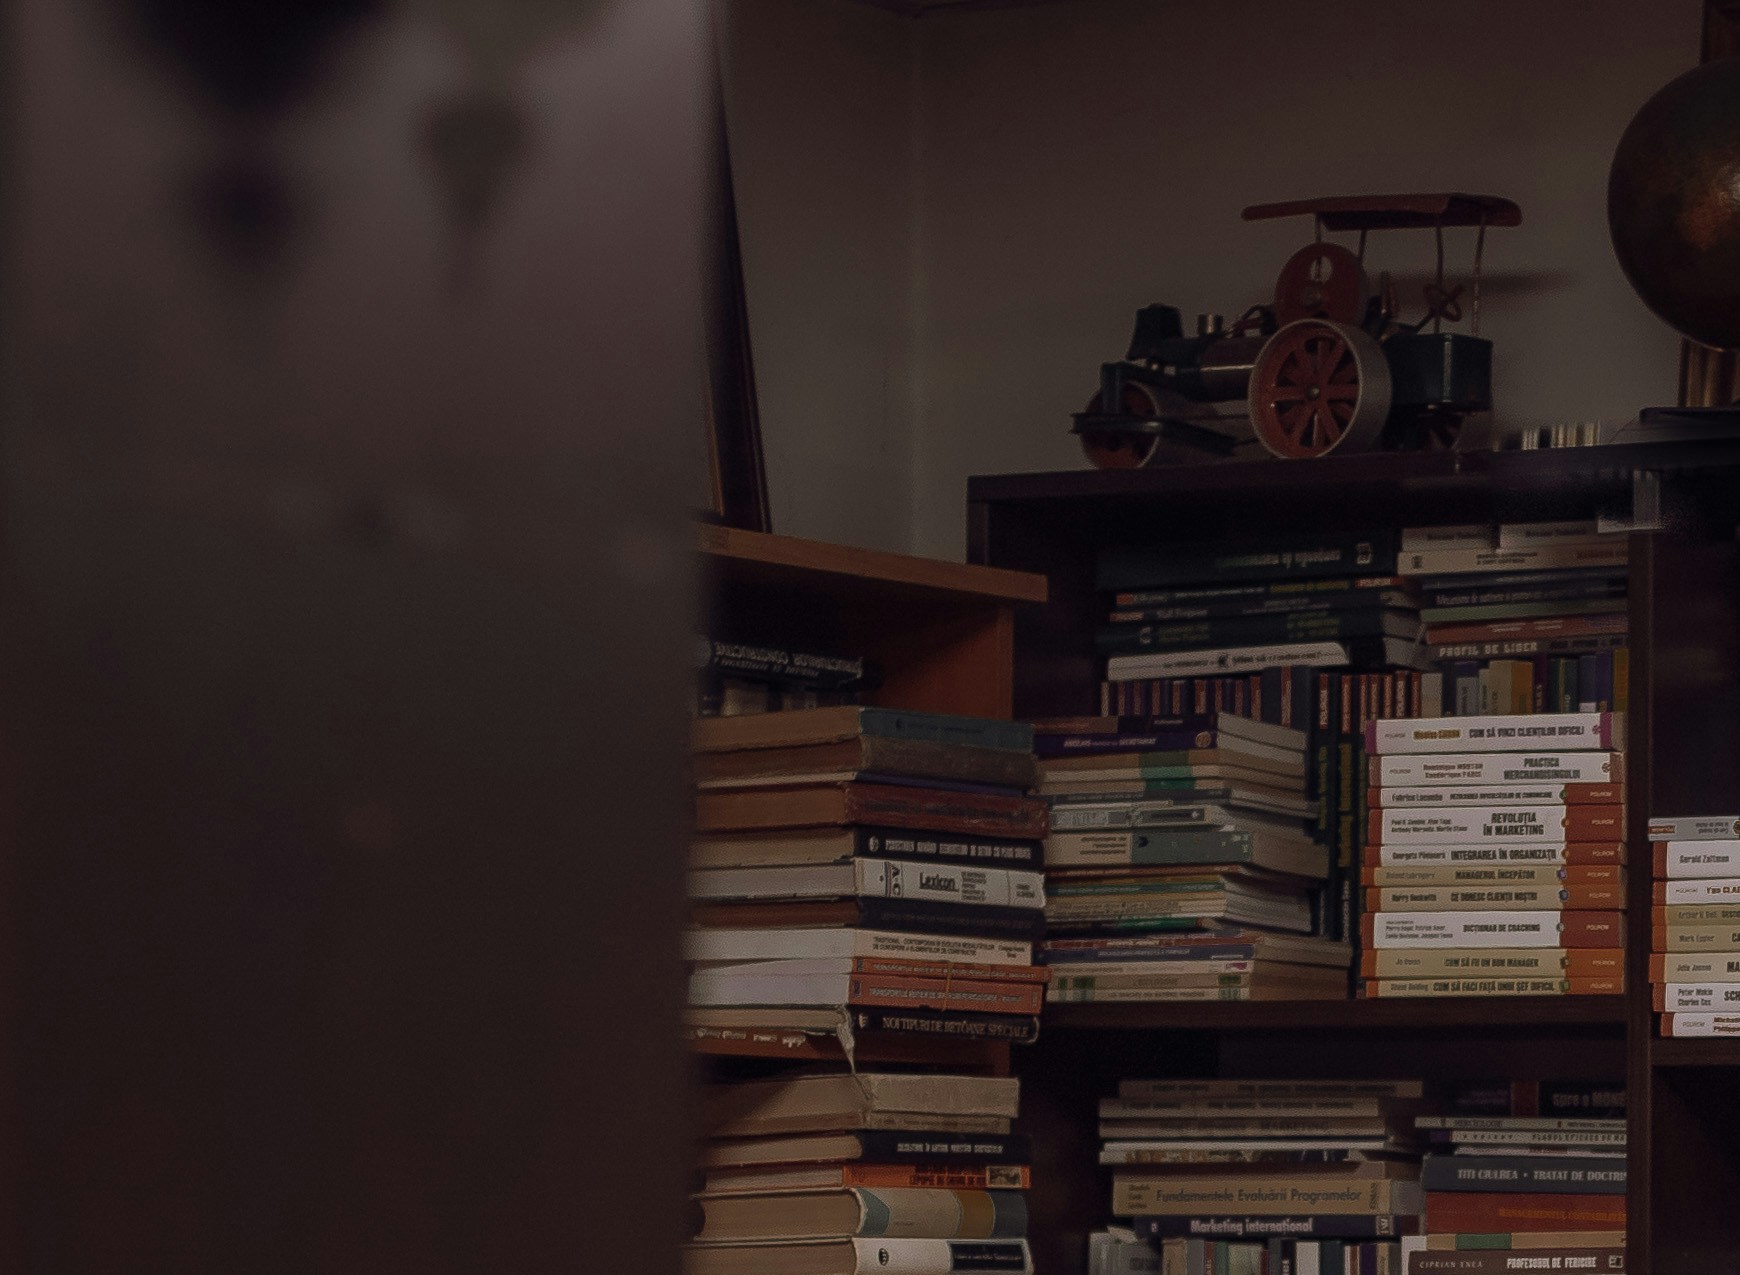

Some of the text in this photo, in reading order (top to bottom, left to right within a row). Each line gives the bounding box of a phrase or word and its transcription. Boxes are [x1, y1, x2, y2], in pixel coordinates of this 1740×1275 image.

[1491, 812, 1537, 825] REVOLUȚIA
[1495, 824, 1544, 836] MARKETING
[919, 873, 959, 891] Lexicon
[1190, 1220, 1242, 1235] Marketing
